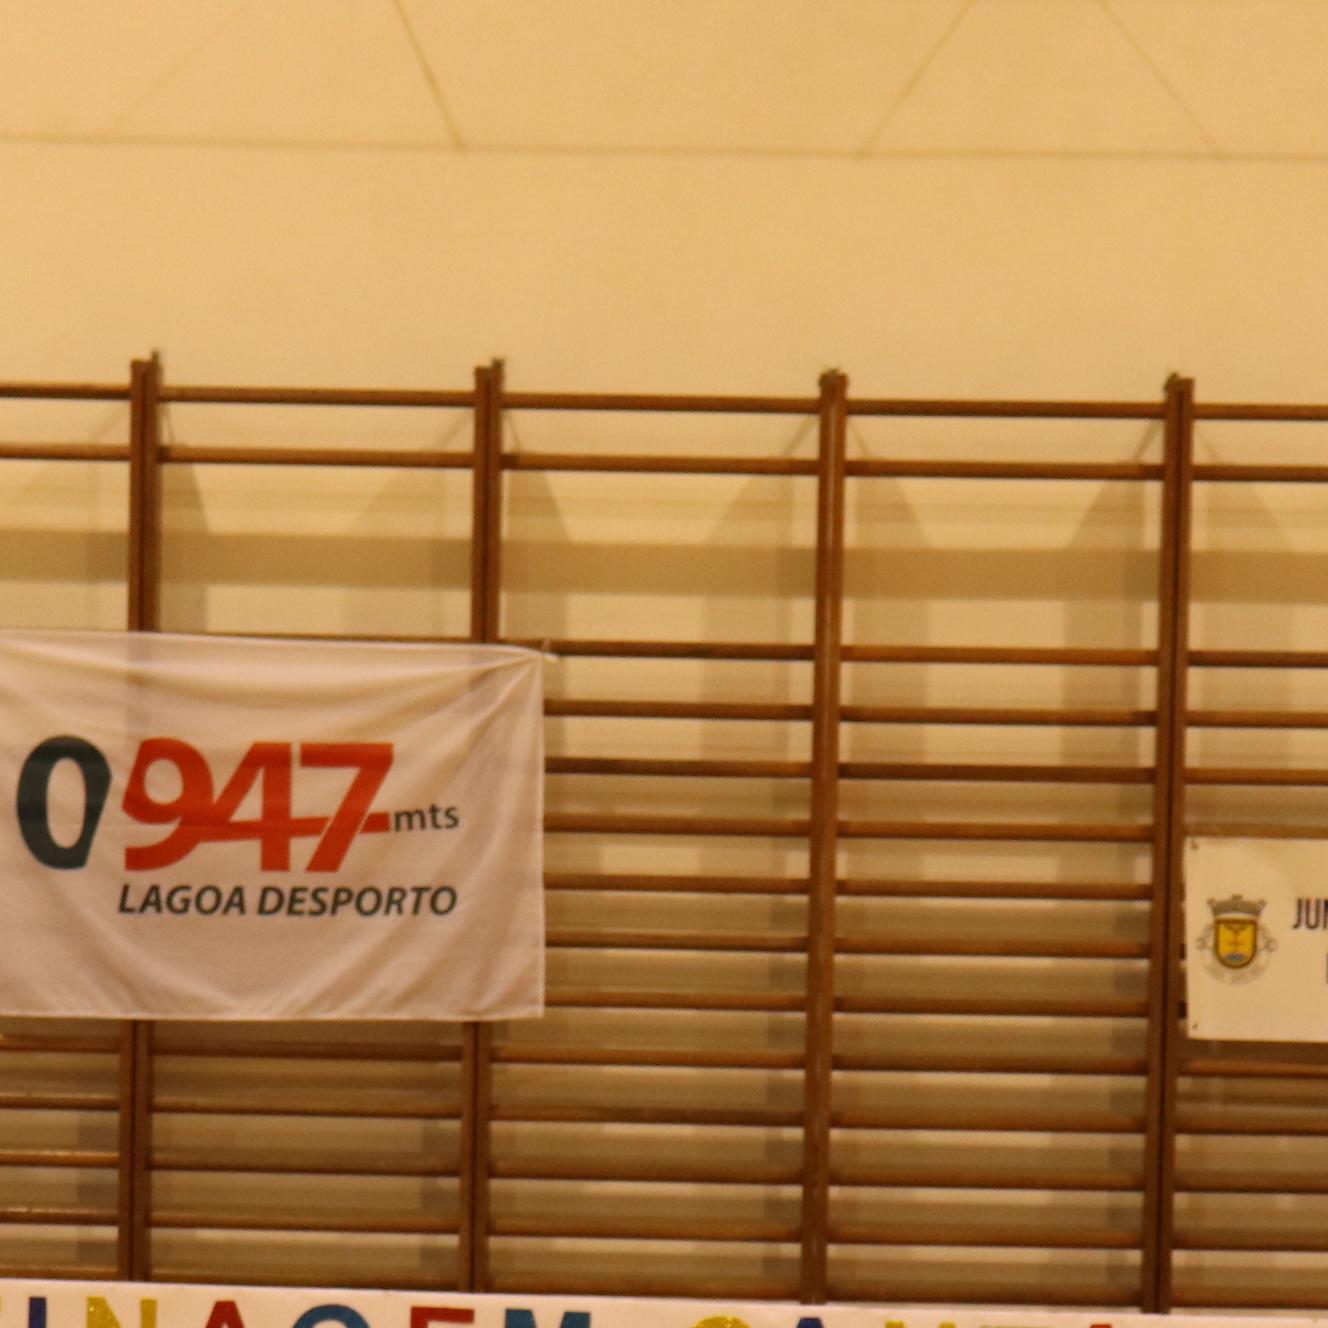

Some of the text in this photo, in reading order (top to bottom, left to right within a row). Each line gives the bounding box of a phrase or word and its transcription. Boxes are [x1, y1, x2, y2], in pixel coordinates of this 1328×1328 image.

[394, 802, 460, 833] mts
[118, 884, 458, 918] LAGOA DESPORTO
